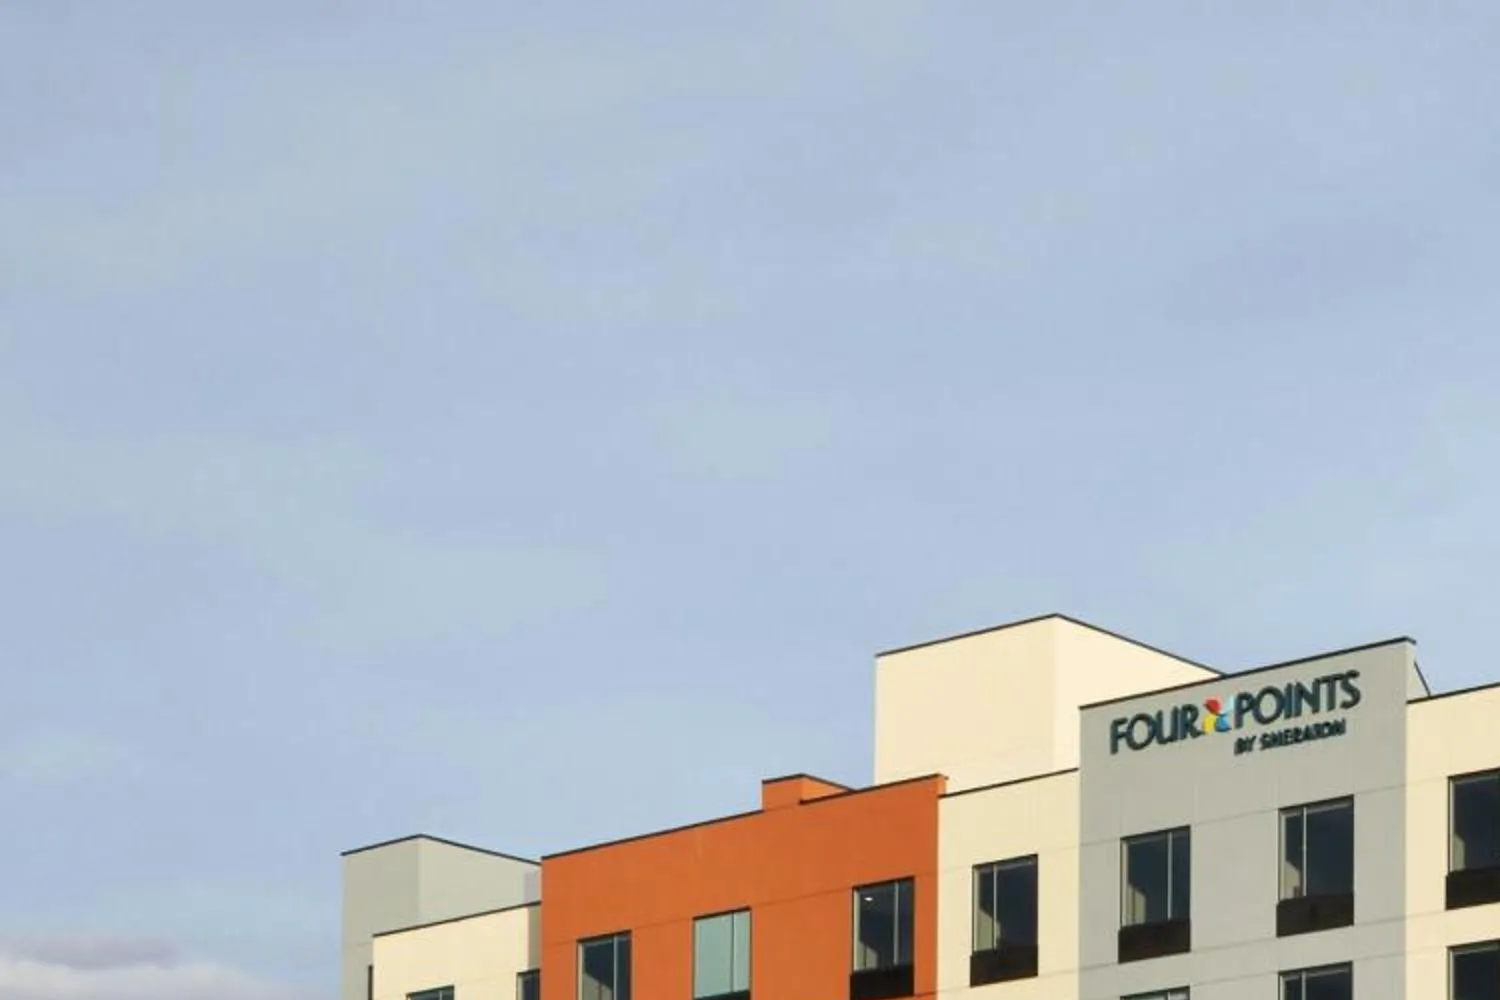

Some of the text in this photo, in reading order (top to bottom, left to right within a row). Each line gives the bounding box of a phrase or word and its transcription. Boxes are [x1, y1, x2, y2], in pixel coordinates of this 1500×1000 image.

[1110, 669, 1361, 754] FOUR POINTS
[1234, 734, 1256, 755] BY
